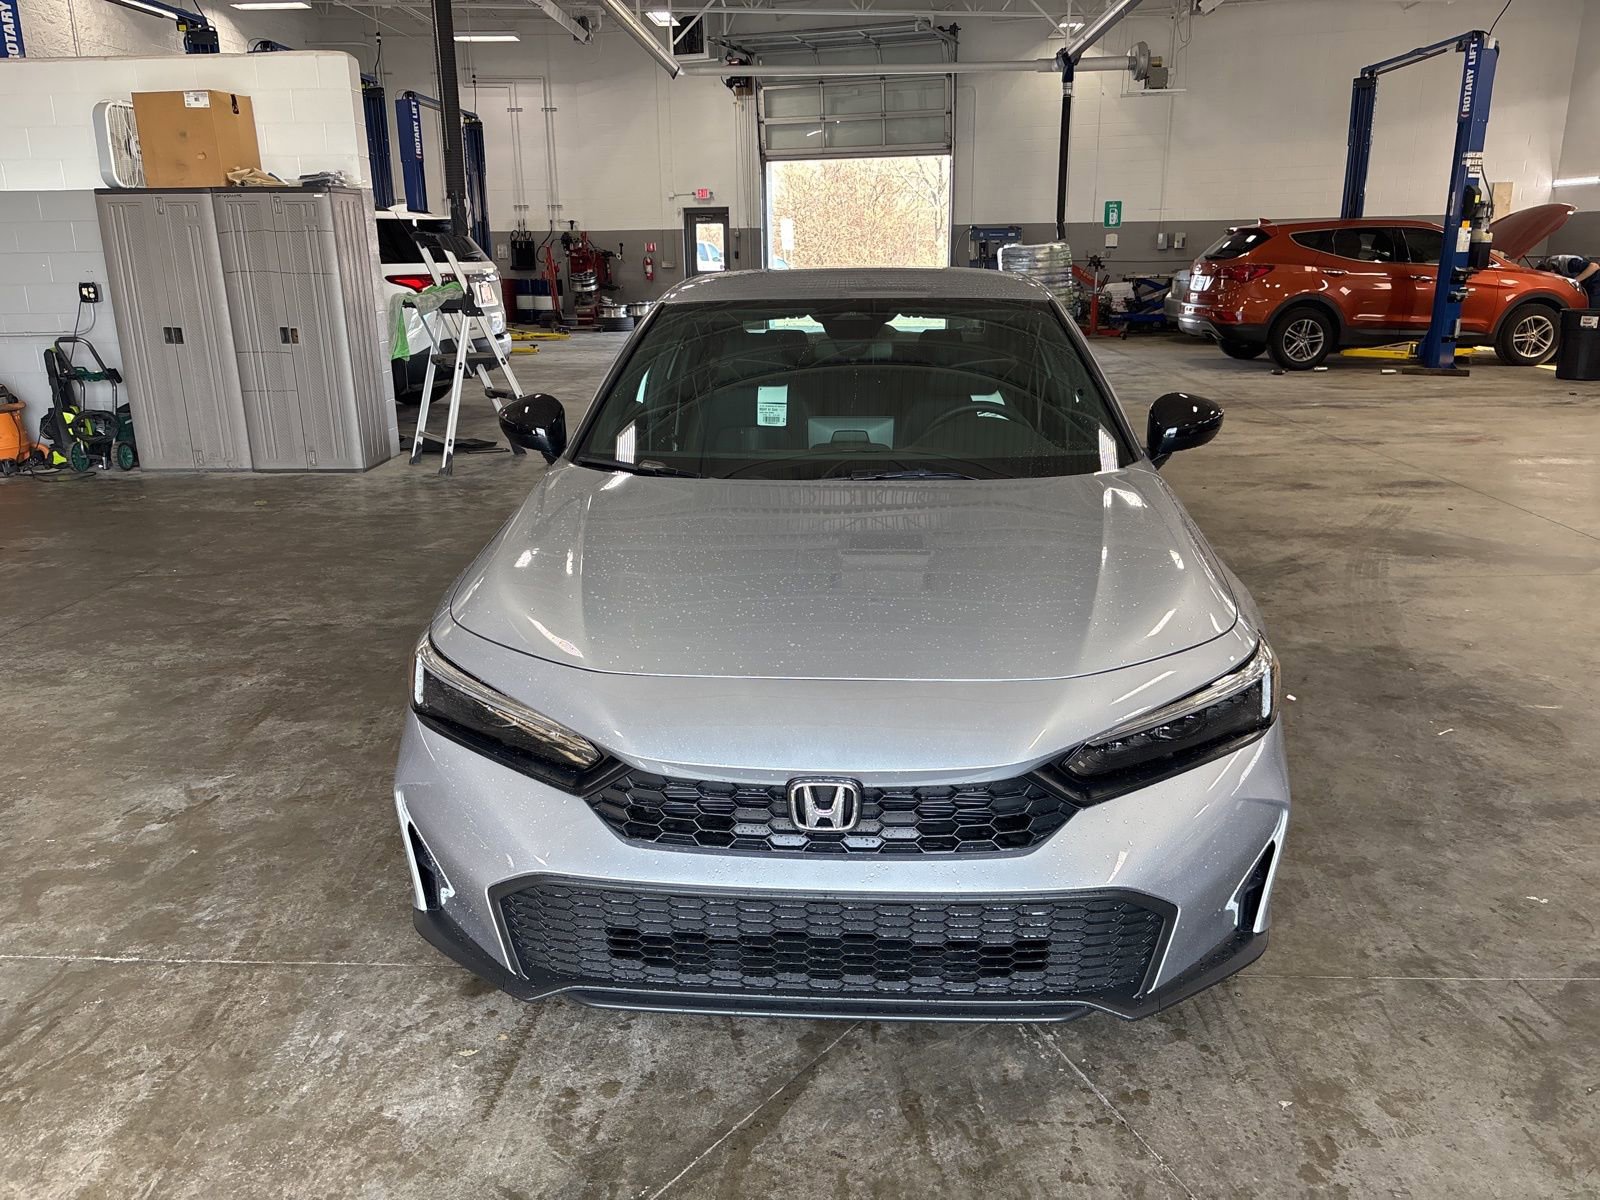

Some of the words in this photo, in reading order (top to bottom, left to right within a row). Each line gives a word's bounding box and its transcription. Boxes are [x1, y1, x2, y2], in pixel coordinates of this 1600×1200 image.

[1462, 69, 1474, 112] ROTARY
[1468, 43, 1478, 66] LIFT
[411, 101, 419, 119] LIFT
[413, 121, 422, 154] ROTARY
